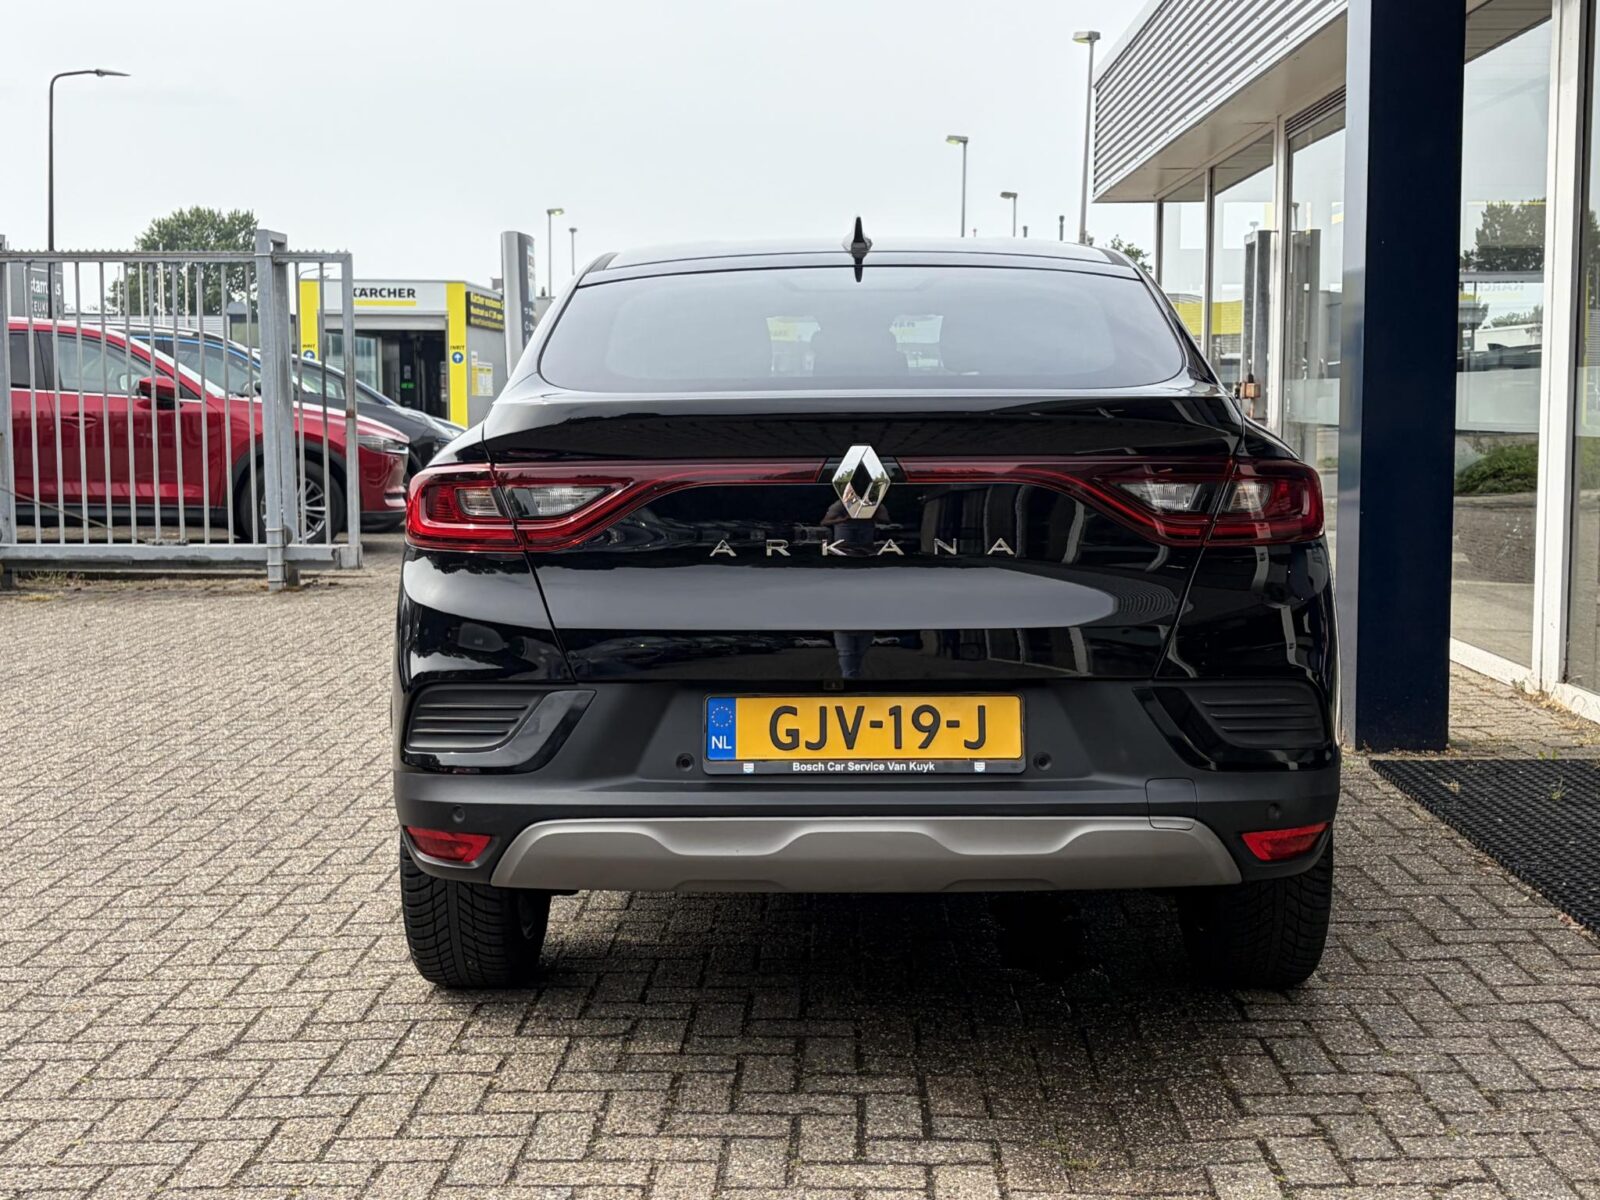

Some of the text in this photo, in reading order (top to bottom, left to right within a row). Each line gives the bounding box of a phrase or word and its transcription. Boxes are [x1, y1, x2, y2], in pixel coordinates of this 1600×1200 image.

[709, 538, 1016, 557] ARKANA
[769, 704, 987, 751] GJV-19-J
[711, 735, 732, 749] NL
[792, 761, 936, 774] Bosch Car Service Van Kuyk
